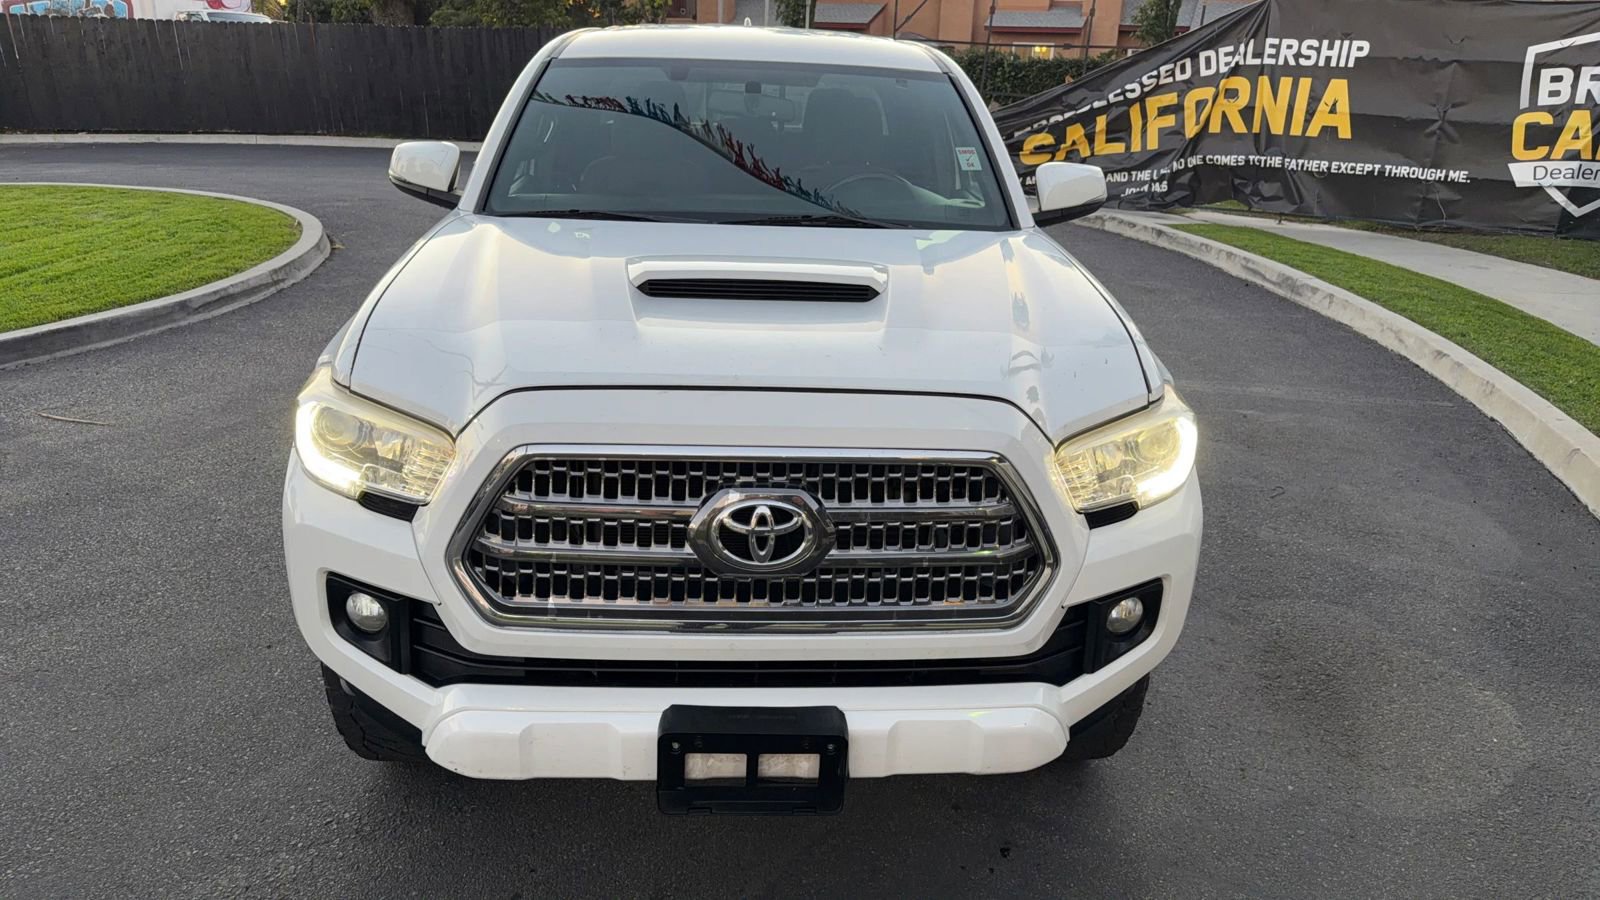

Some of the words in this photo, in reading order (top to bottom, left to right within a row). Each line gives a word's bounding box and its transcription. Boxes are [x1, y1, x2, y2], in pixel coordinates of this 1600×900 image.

[1199, 37, 1371, 77] DEALERSHIP
[1019, 75, 1352, 166] CALIFORNIA
[1511, 109, 1600, 161] CA
[1106, 172, 1128, 183] AND
[1131, 170, 1151, 181] THE
[1206, 154, 1245, 166] COMES
[1260, 155, 1283, 168] THE
[1284, 158, 1328, 173] FATHER
[1330, 161, 1382, 176] EXCEPT
[1384, 165, 1446, 181] THROUGH
[1447, 170, 1471, 183] ME.
